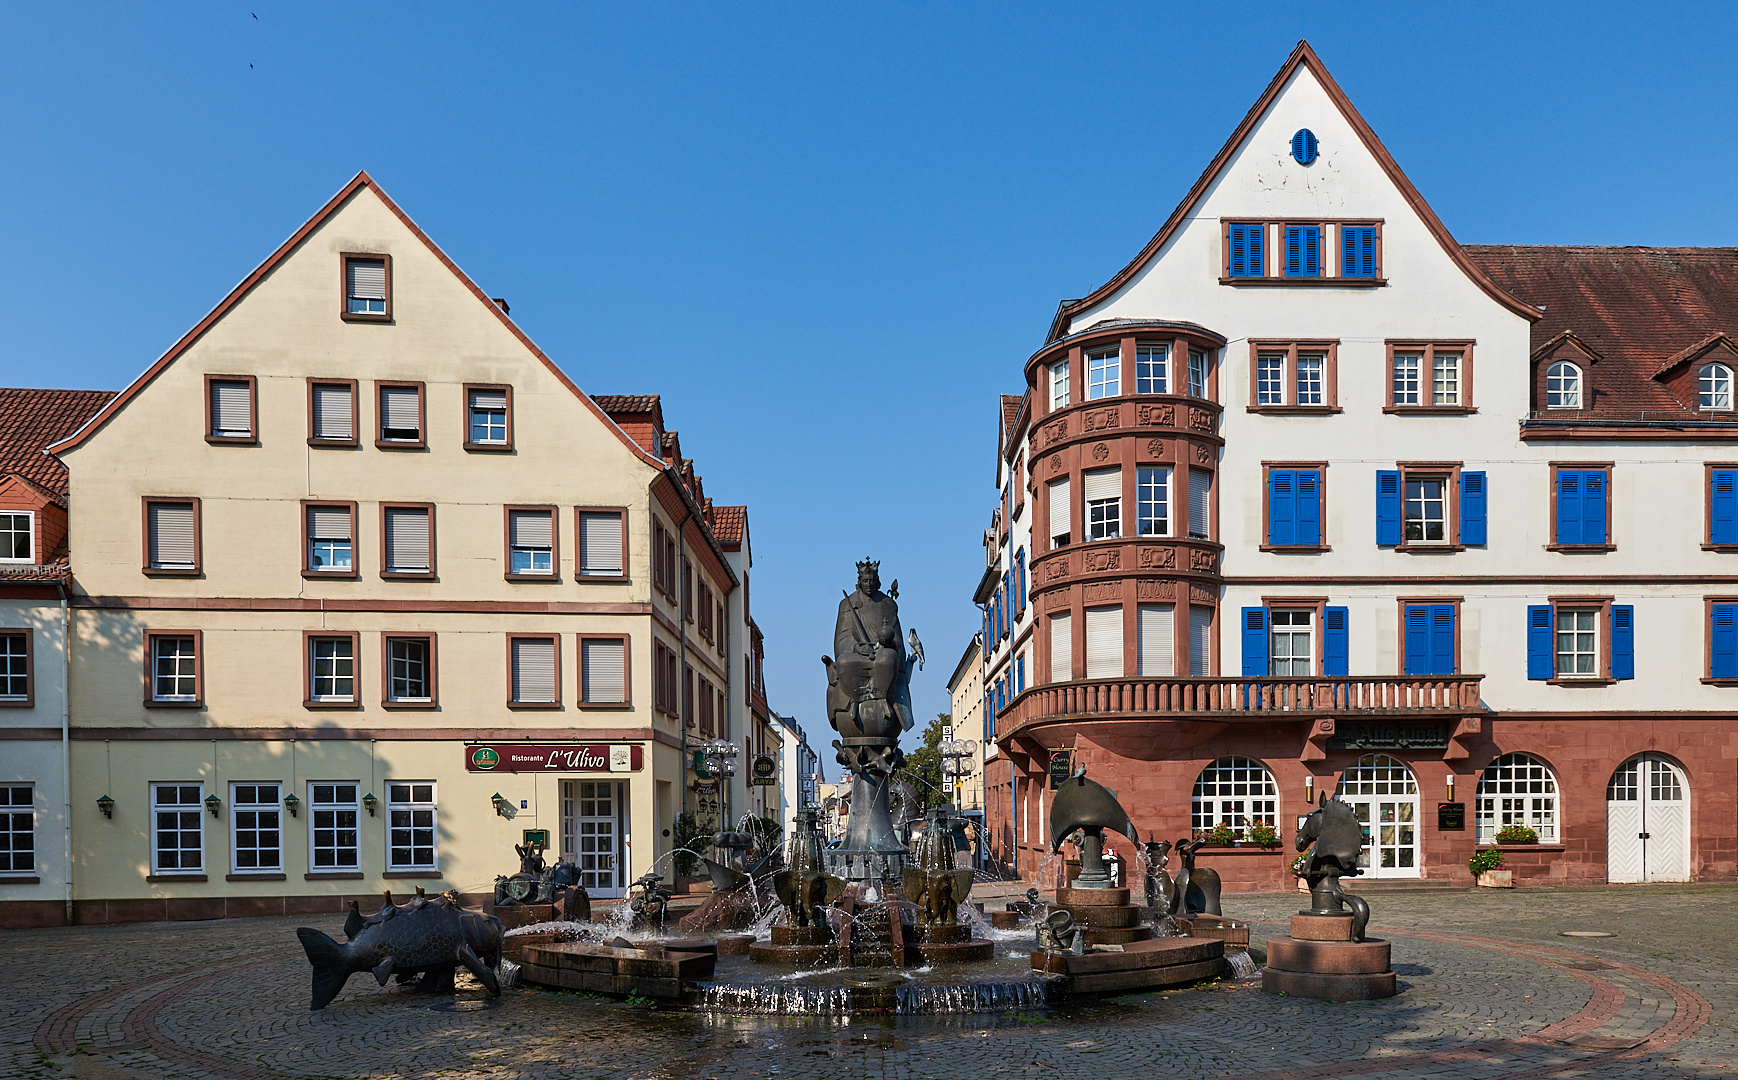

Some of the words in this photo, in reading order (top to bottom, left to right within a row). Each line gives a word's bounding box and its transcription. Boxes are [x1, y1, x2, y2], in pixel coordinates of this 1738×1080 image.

[1358, 725, 1395, 740] Alte
[1399, 724, 1442, 740] Post
[511, 754, 544, 762] Ristorante
[545, 747, 605, 768] L'Ulivo
[1053, 756, 1070, 765] Curry
